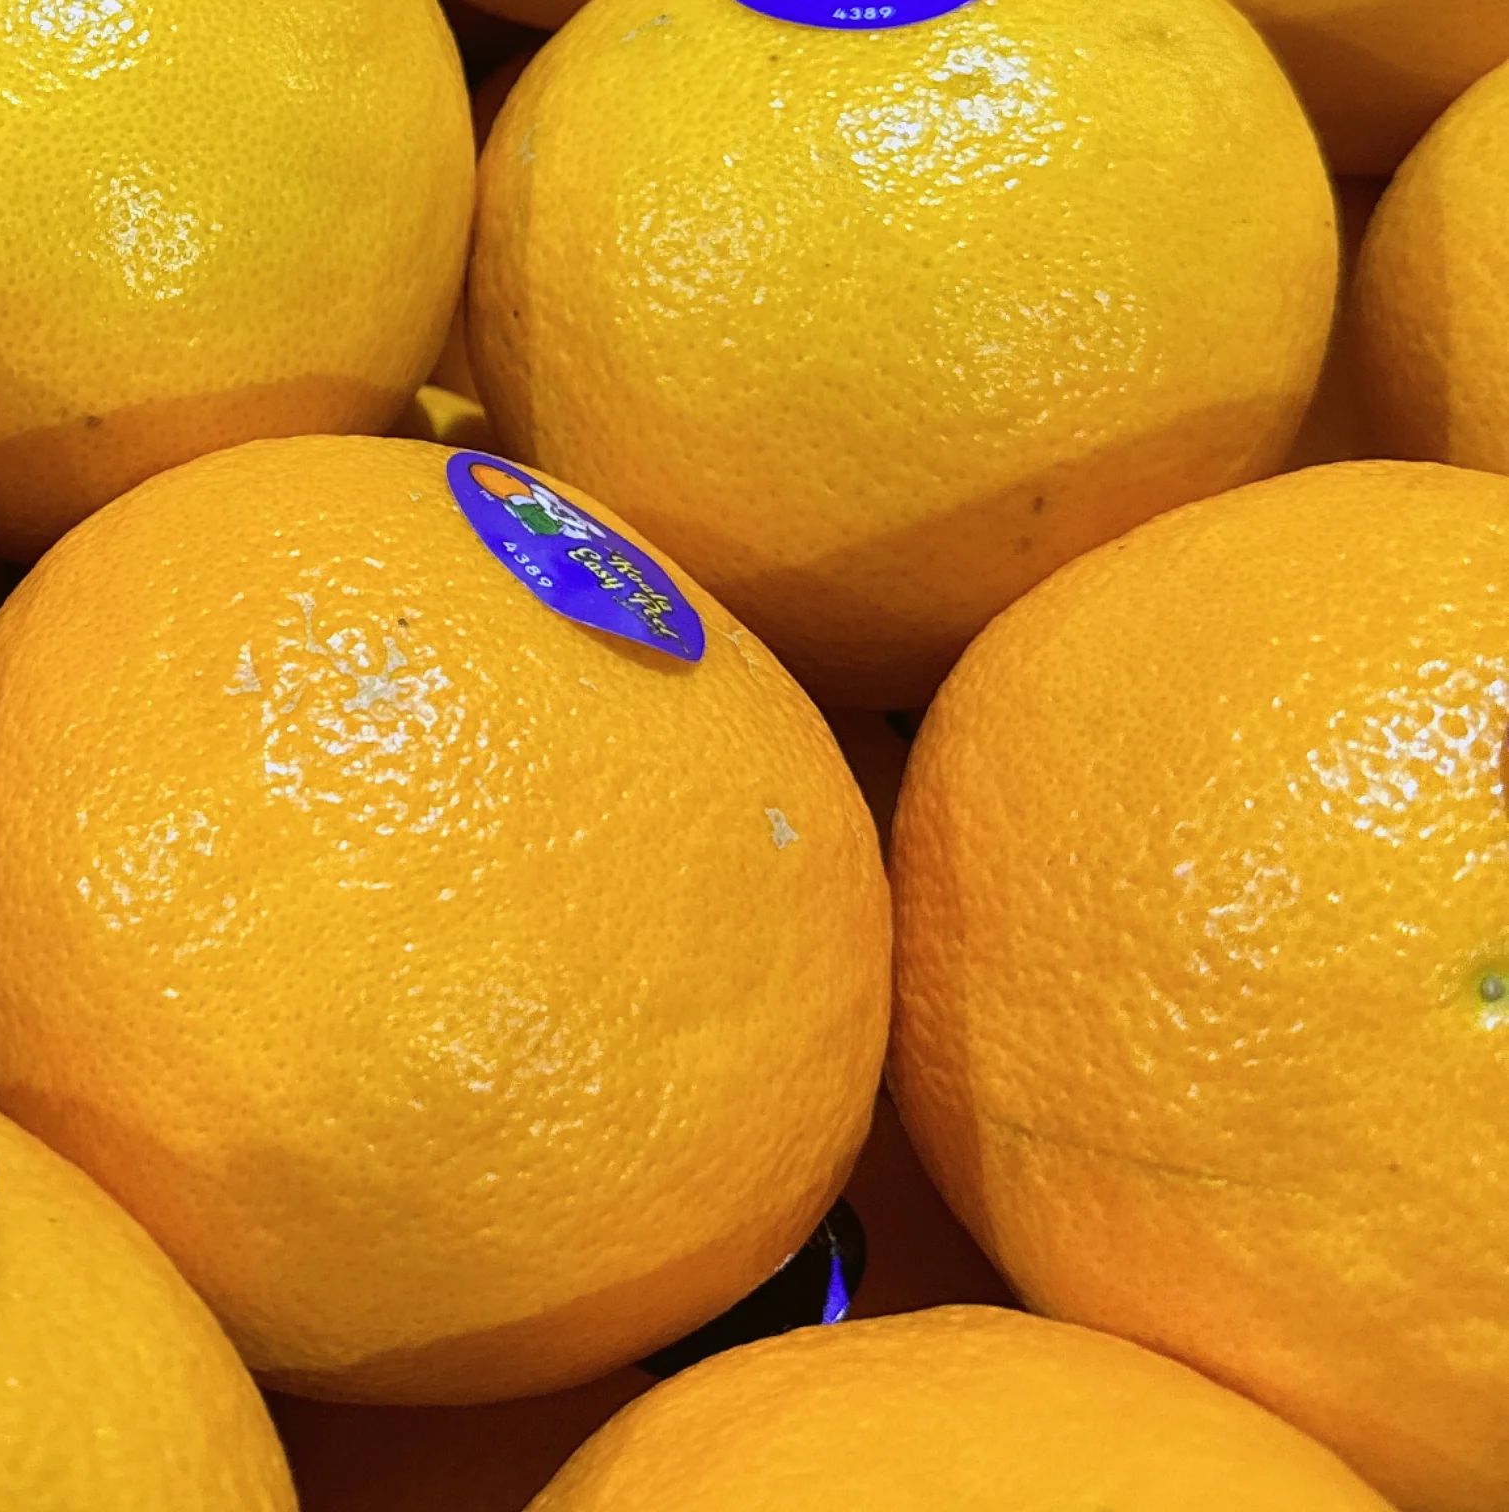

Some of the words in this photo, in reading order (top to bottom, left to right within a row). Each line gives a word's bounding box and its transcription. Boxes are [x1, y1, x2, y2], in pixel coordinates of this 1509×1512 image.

[832, 6, 895, 20] 4389
[503, 541, 553, 588] 4389
[567, 546, 625, 589] Easy
